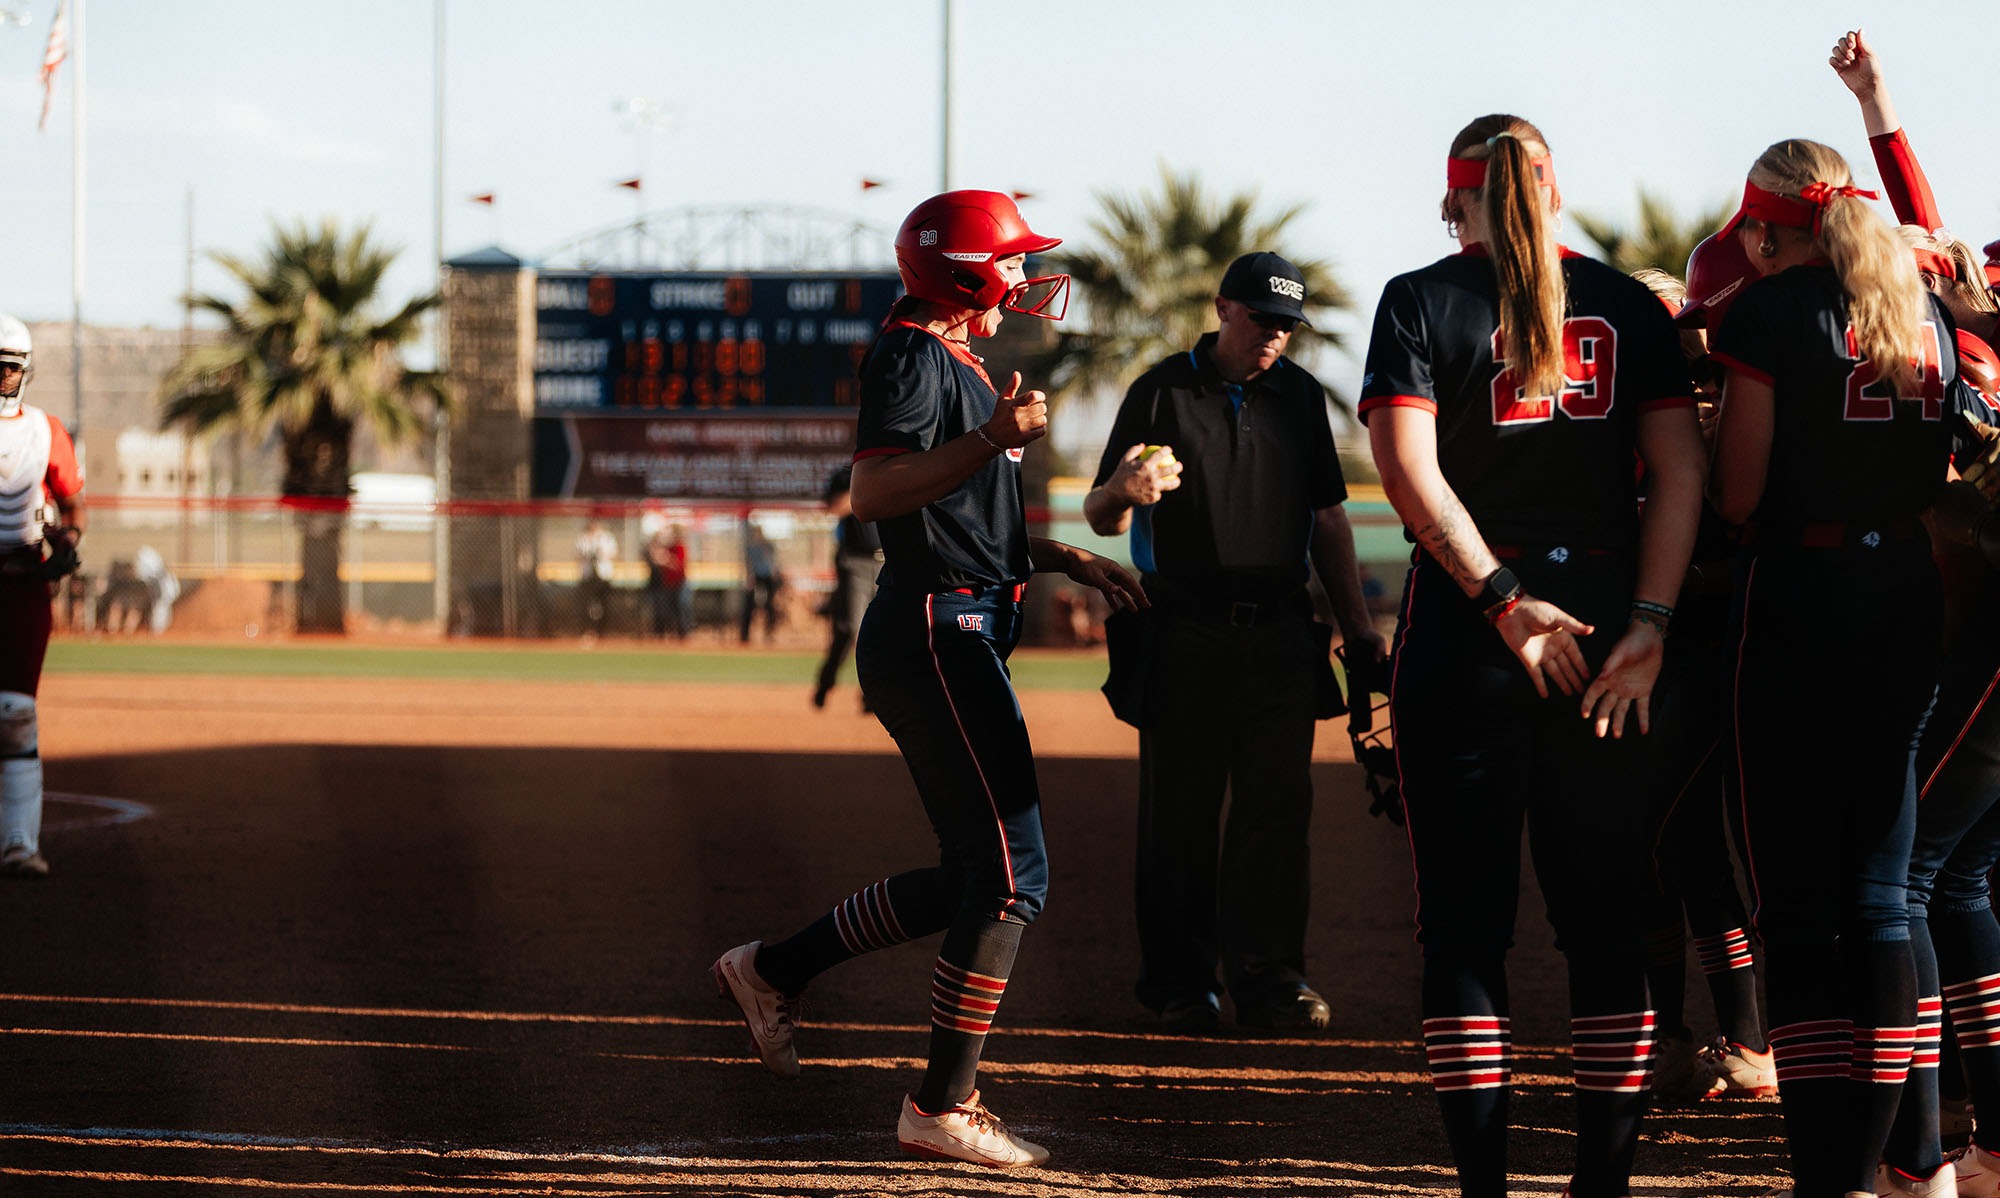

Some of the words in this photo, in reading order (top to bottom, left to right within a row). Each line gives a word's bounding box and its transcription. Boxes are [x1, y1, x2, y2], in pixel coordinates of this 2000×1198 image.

[919, 230, 938, 246] 20
[787, 281, 836, 311] OUT
[537, 339, 610, 373] GUEST
[1490, 316, 1617, 425] 29
[1843, 321, 1945, 421] 24
